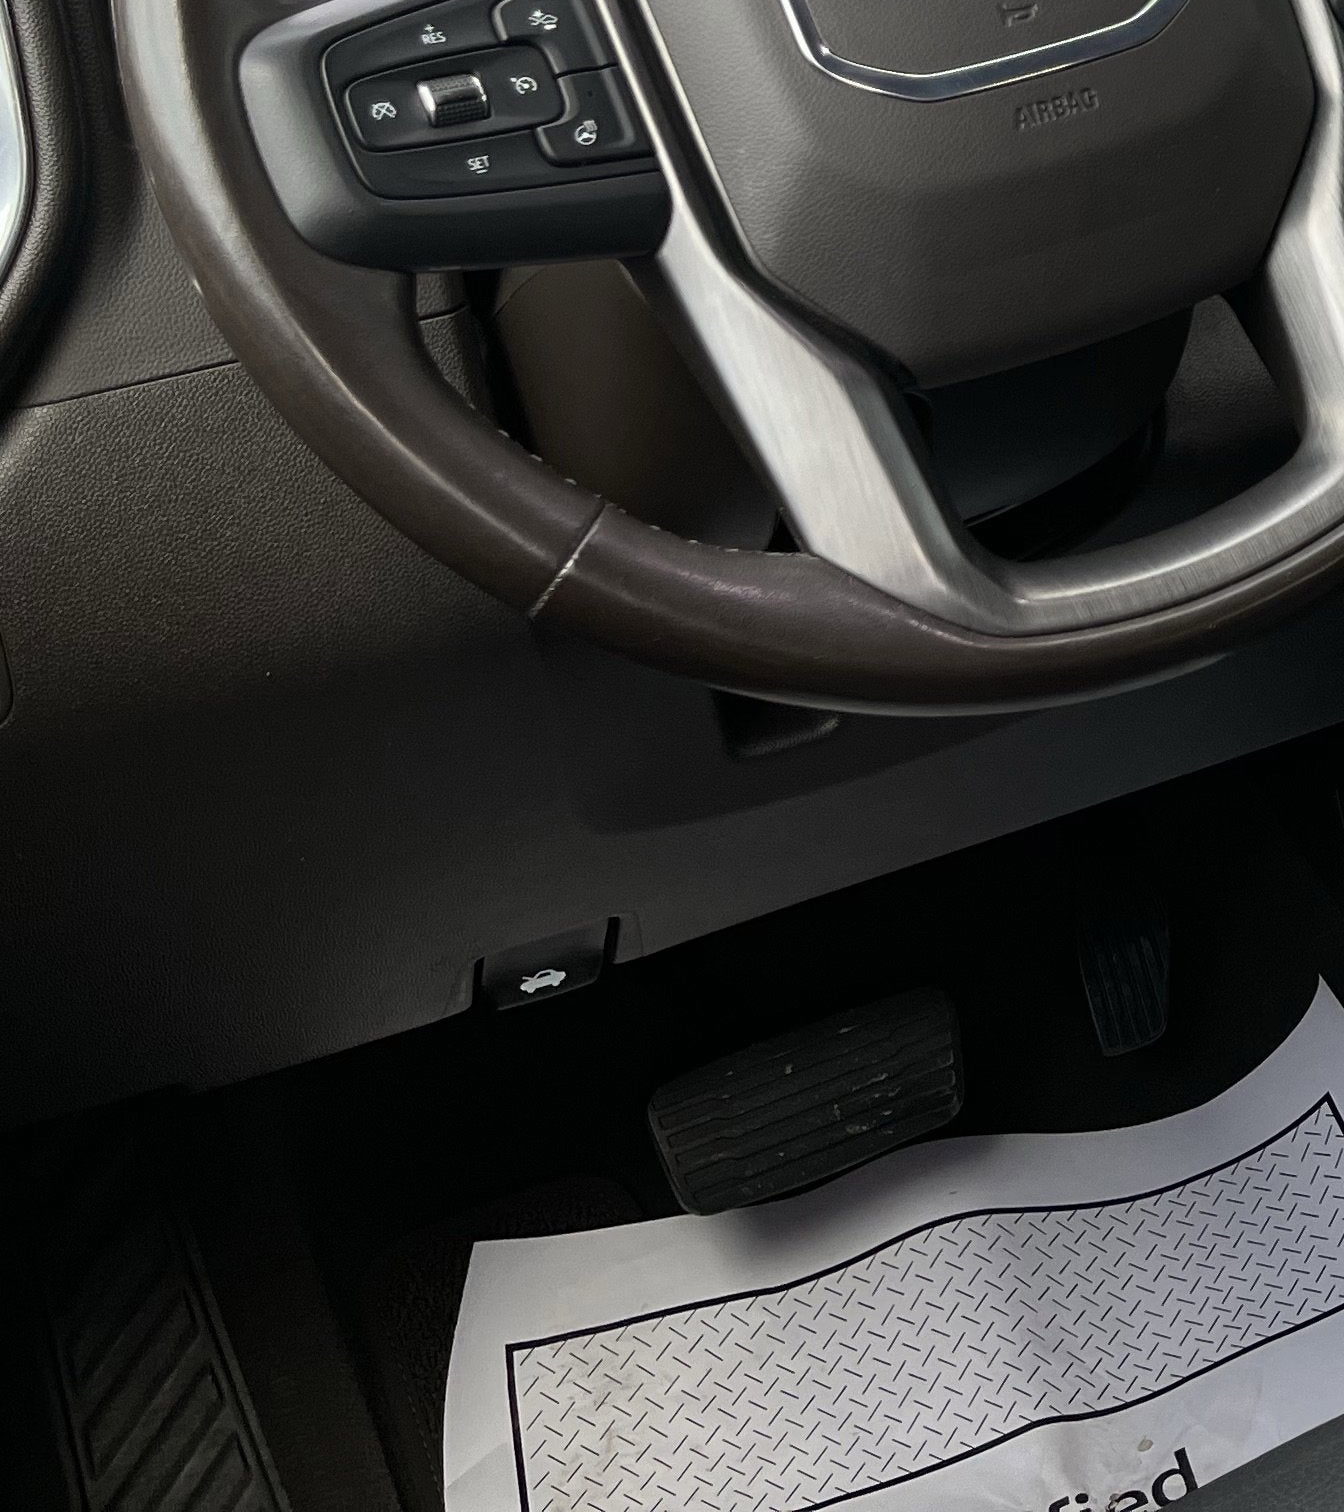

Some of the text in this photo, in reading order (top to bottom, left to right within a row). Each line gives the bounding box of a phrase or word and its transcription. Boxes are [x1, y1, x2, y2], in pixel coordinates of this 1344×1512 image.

[421, 31, 447, 45] RES
[1013, 89, 1100, 131] AIRBAG
[466, 154, 490, 171] SET
